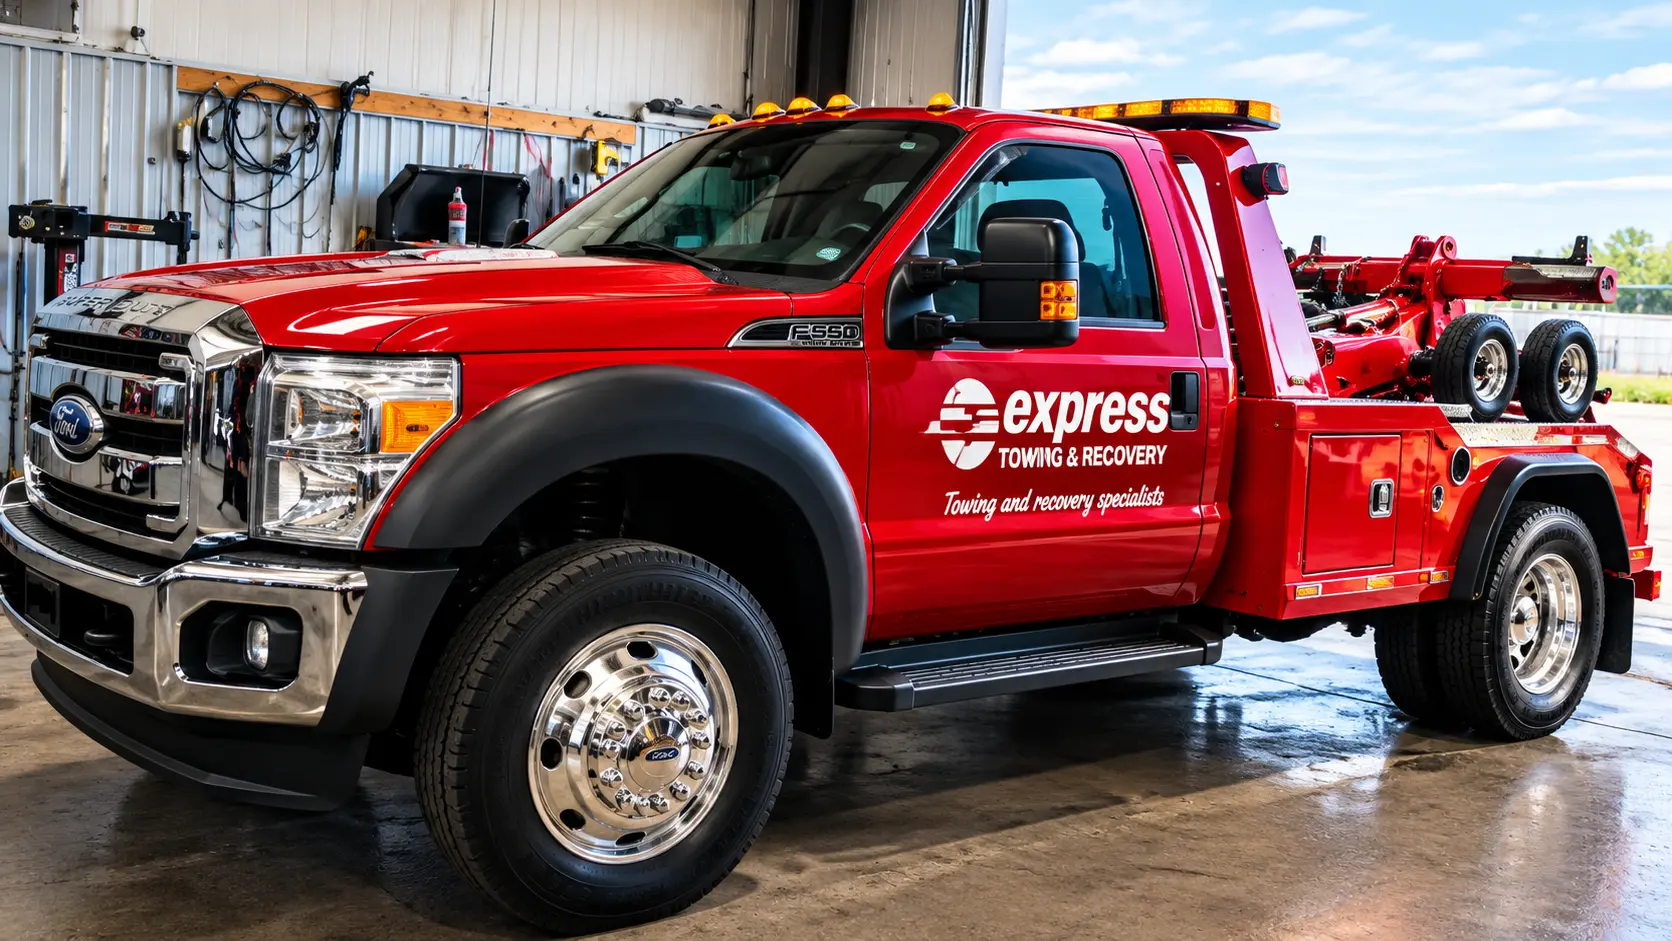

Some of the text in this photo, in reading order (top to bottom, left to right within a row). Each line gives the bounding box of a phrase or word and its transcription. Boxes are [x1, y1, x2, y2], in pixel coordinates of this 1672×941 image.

[1003, 389, 1171, 443] express
[999, 444, 1168, 469] TOWING & RECOVERY
[943, 484, 1165, 522] Towing and recovery specialists
